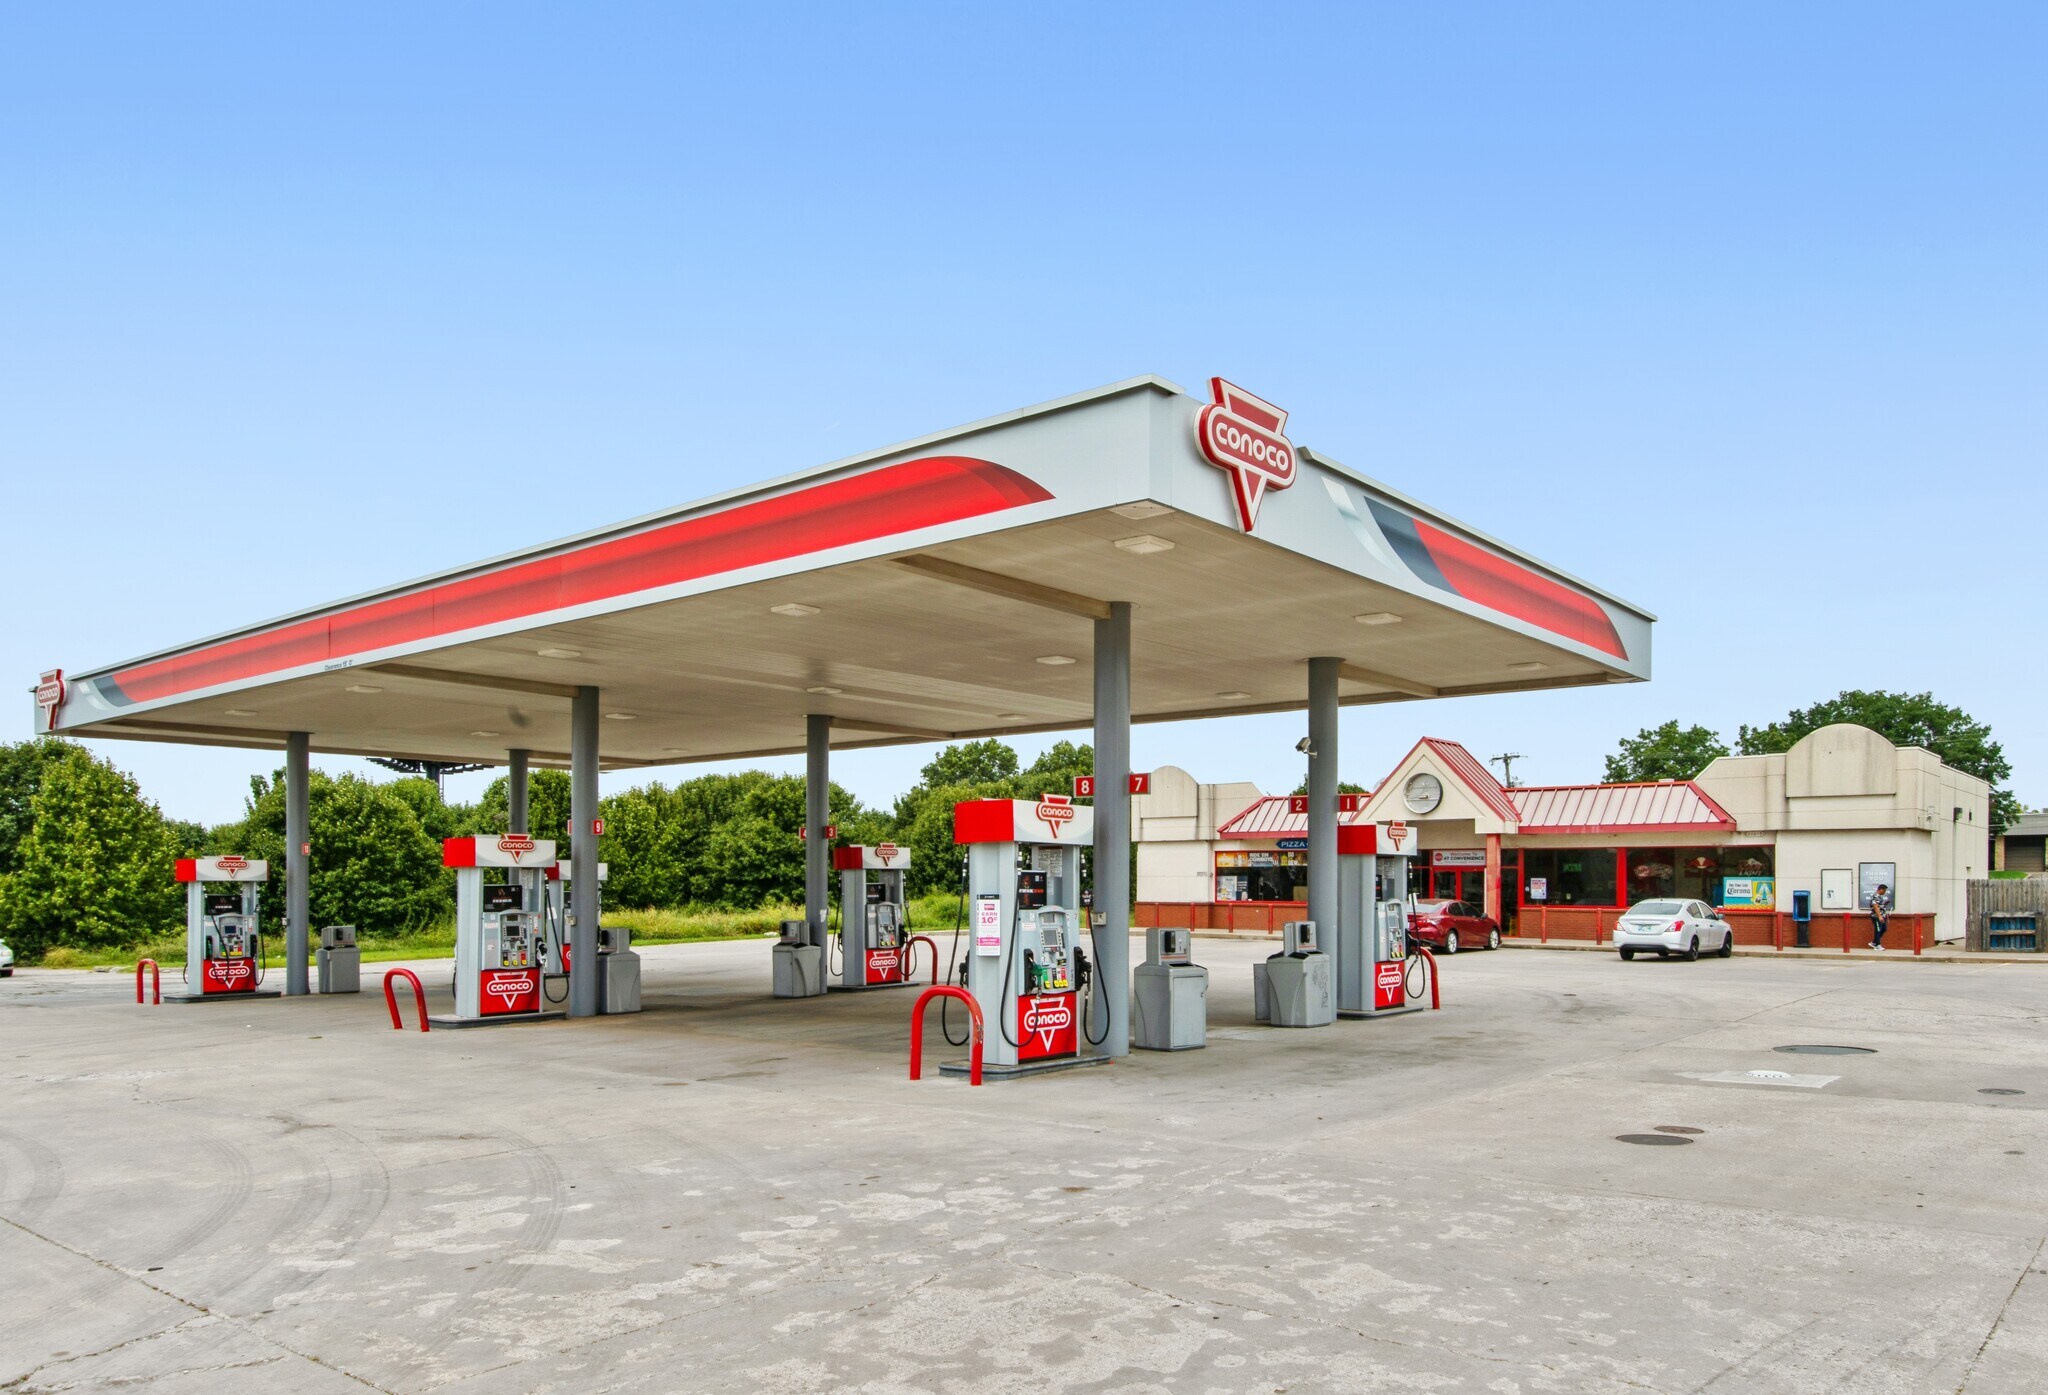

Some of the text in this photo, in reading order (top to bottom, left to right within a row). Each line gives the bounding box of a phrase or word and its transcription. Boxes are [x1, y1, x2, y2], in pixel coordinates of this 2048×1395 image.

[1215, 422, 1289, 471] conoco
[1081, 780, 1090, 794] 8
[1135, 777, 1143, 791] 7
[1296, 799, 1302, 811] 2
[1347, 798, 1350, 810] 1
[1041, 807, 1073, 817] conoco
[829, 828, 834, 837] 3
[490, 982, 529, 991] conoco
